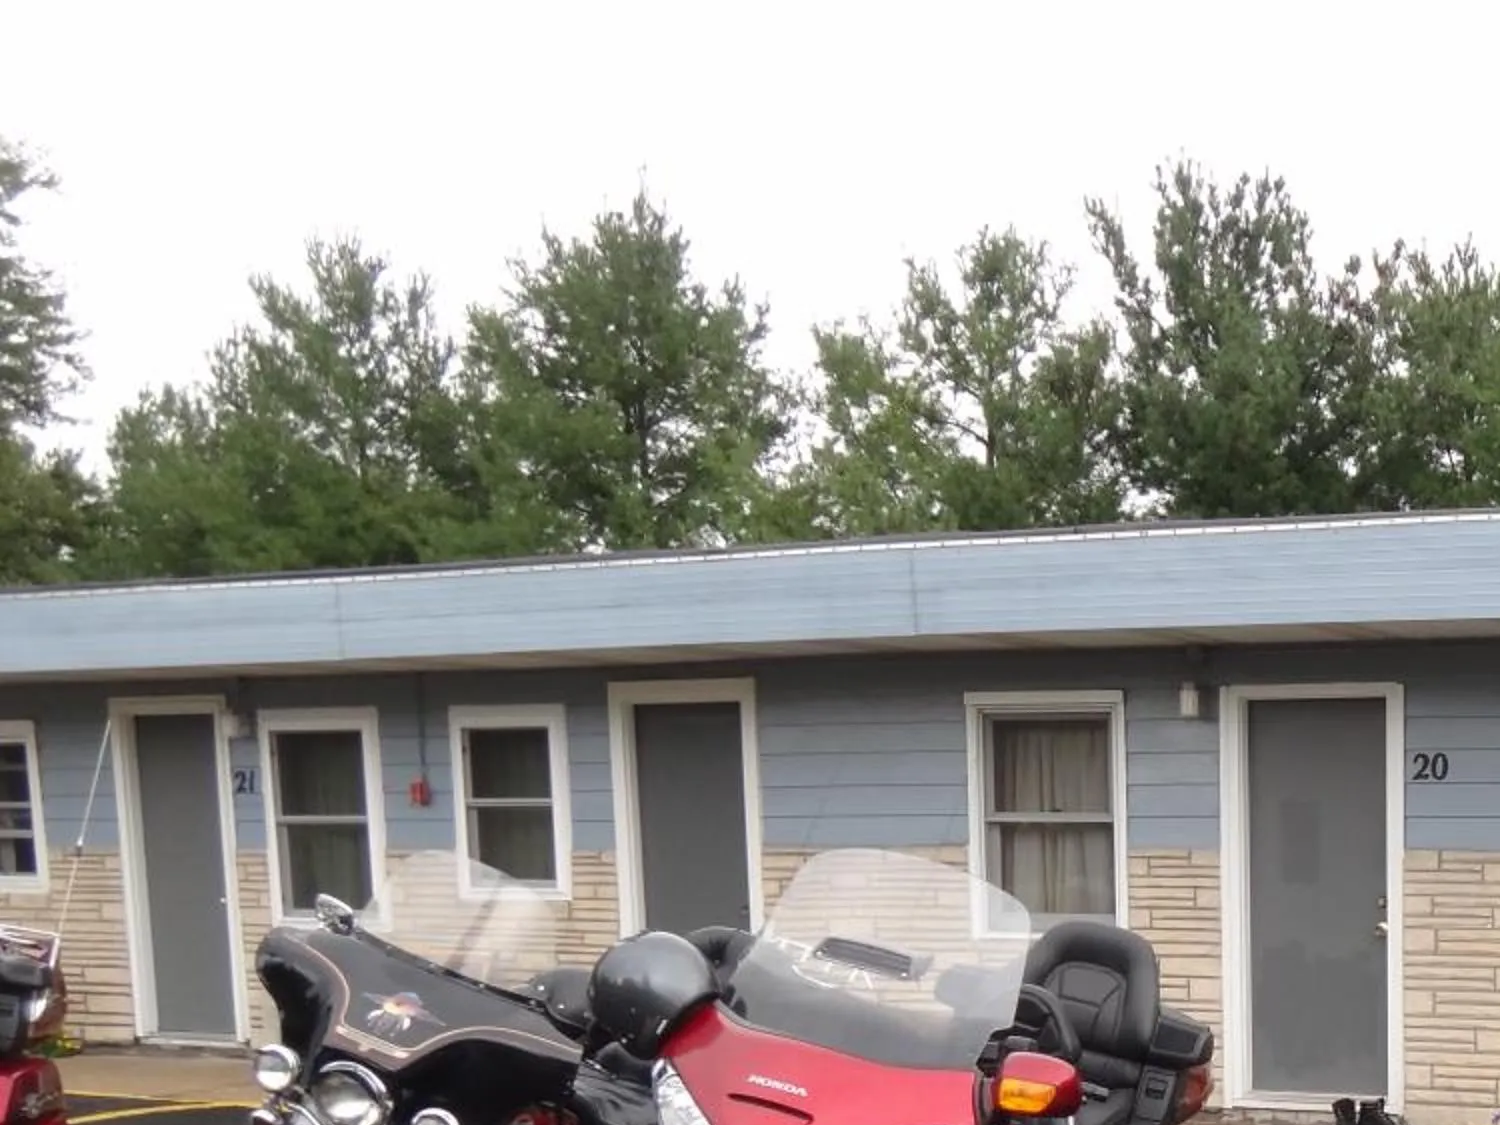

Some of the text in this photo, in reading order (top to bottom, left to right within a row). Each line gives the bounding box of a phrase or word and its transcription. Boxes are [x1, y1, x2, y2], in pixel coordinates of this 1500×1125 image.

[1412, 752, 1449, 780] 20
[234, 770, 255, 794] 21
[747, 1074, 808, 1097] HONDA
